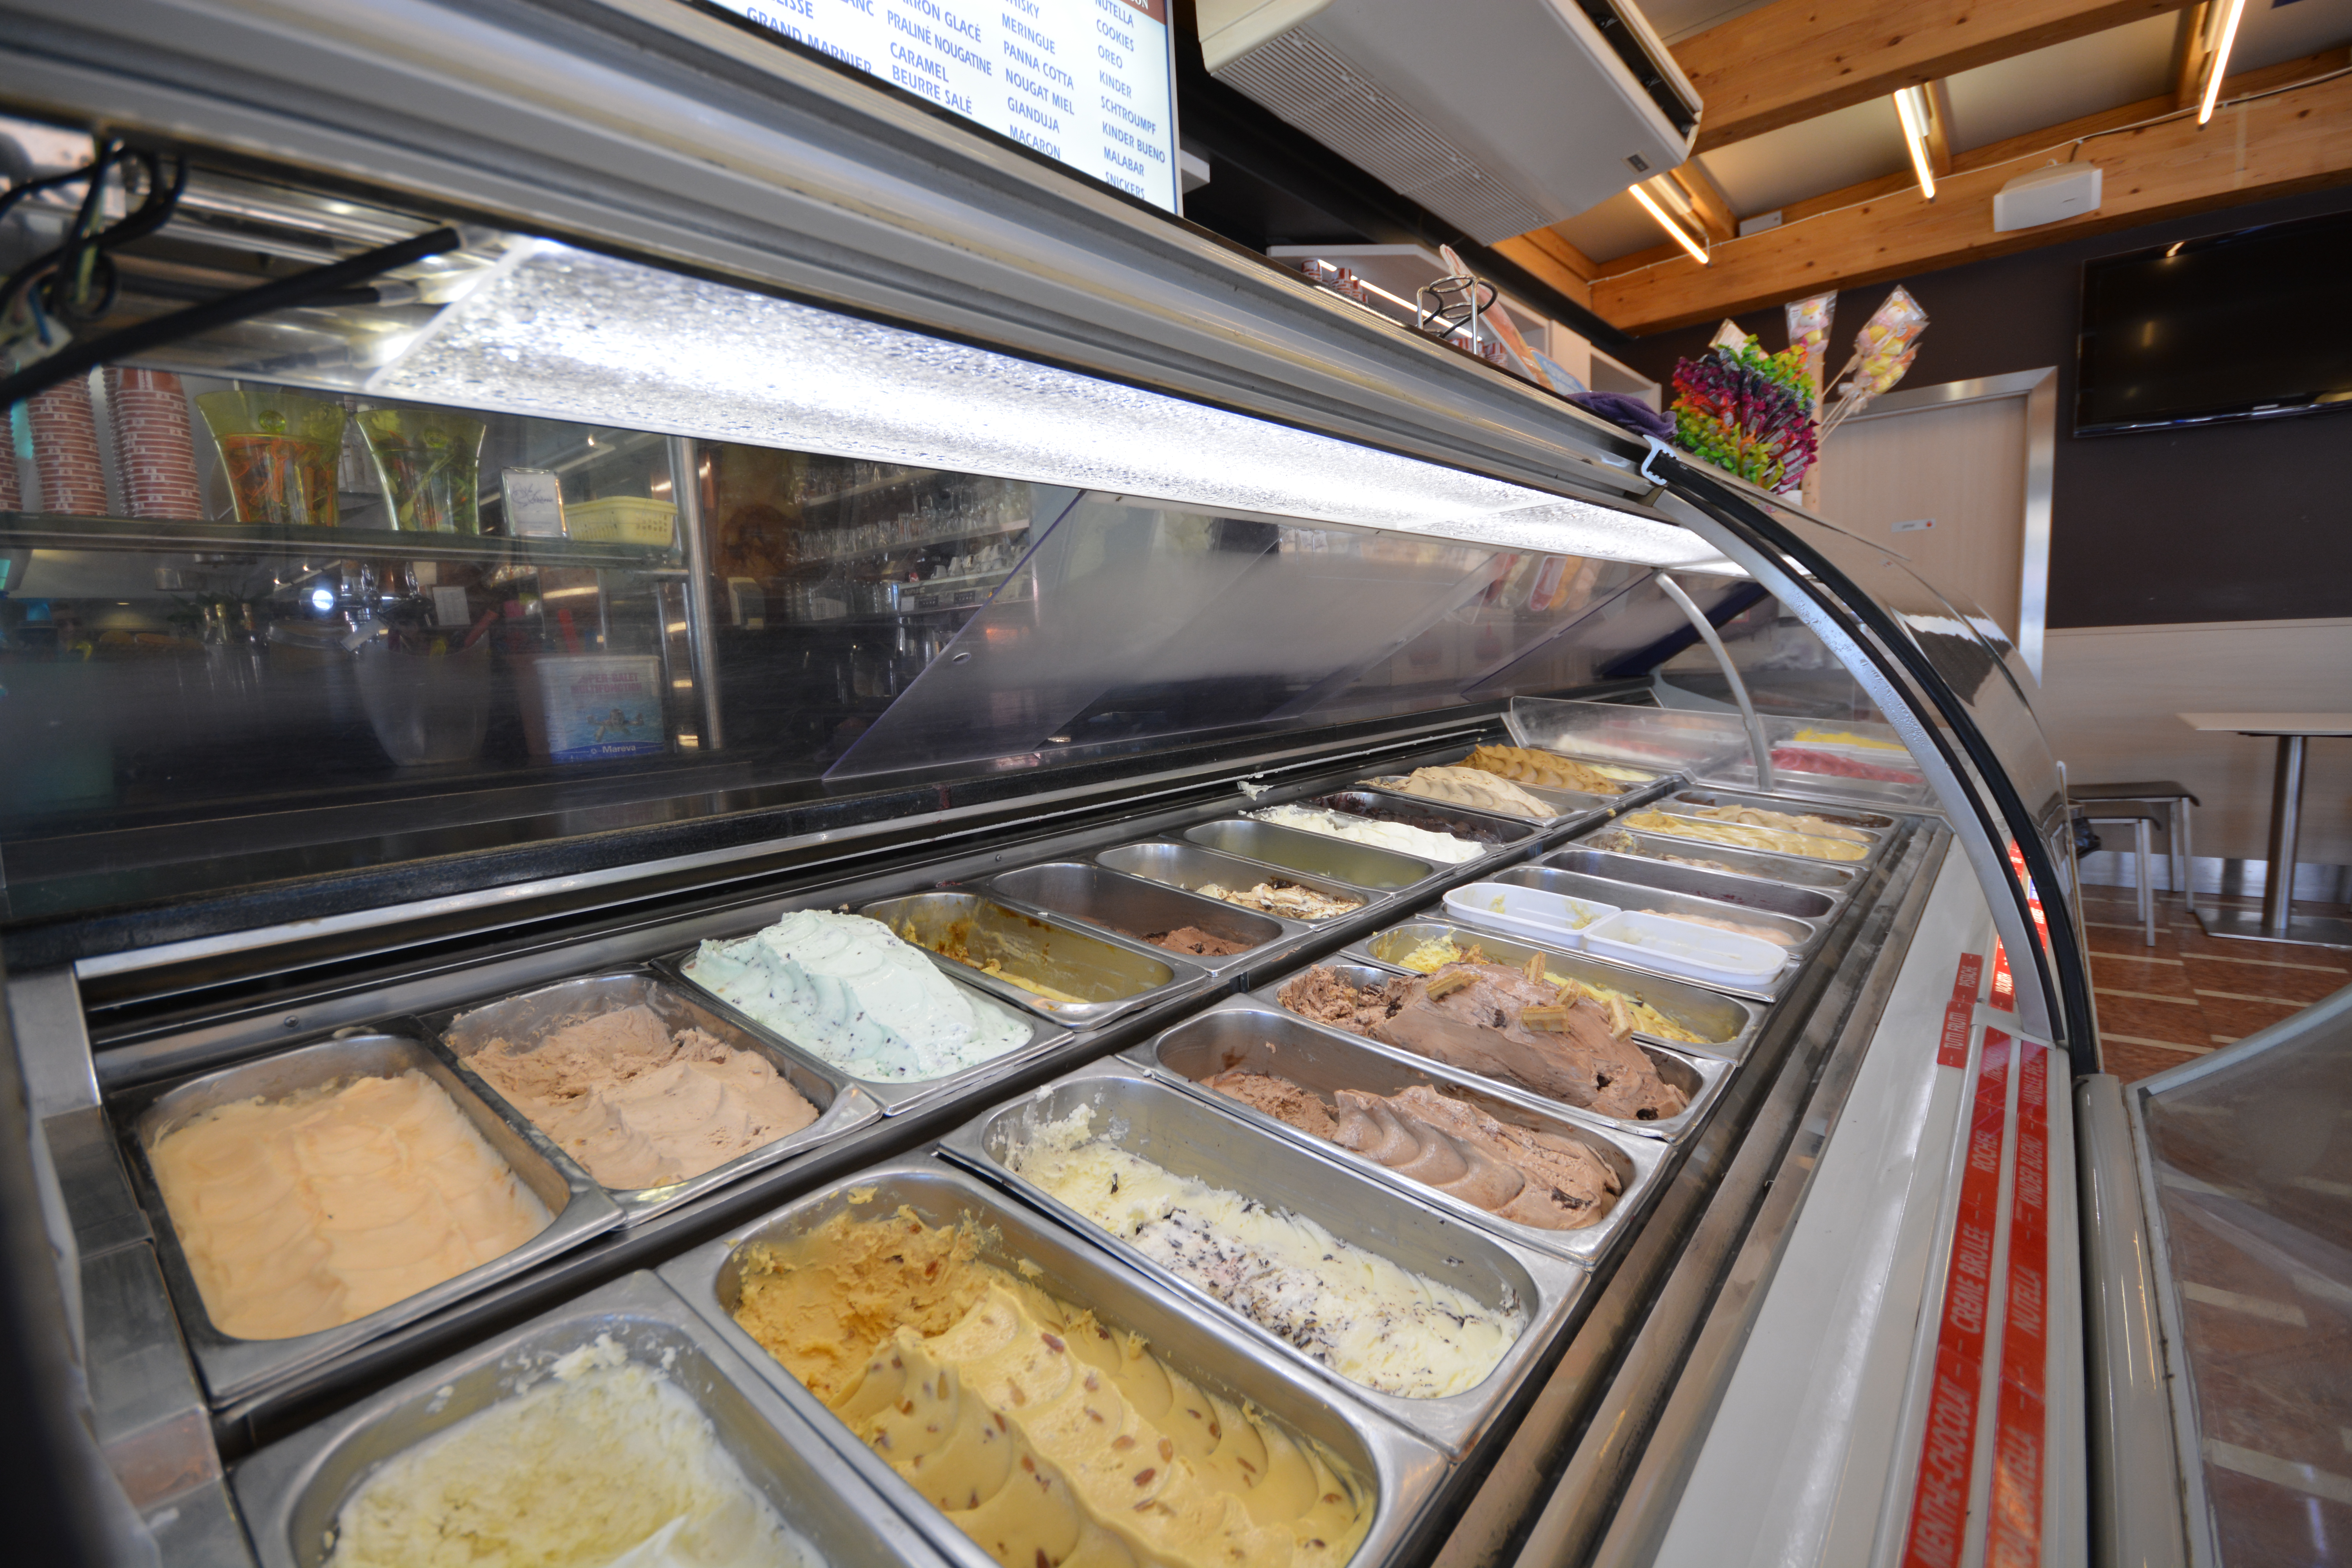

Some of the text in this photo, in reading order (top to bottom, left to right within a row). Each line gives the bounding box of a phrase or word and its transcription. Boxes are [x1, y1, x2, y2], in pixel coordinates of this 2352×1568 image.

[747, 7, 872, 74] GRAND MARNIER
[887, 9, 992, 76] PRALINÉ NOUGATINE
[945, 12, 981, 43] GLACÉ
[1002, 13, 1055, 54] MERINGUE
[1096, 19, 1134, 52] COOKIES
[890, 42, 949, 83] CARAMEL
[1004, 40, 1074, 90] PANNA COTTA
[1098, 45, 1123, 69] OREO
[892, 64, 973, 114] BEURRE SALÉ
[1005, 68, 1074, 115] NOUGAT MIEL
[1100, 70, 1132, 99] KINDER
[1007, 96, 1060, 133] GIANDUJA
[1101, 96, 1156, 135] SCHTROUMPF
[1010, 125, 1060, 160] MACARON
[1102, 121, 1165, 163] KINDER BUENO
[1104, 146, 1144, 176] MALABAR
[1105, 172, 1145, 200] SNICKERS
[1958, 965, 1978, 987] PISTACHE
[1995, 971, 2013, 995] YAOURTH
[1944, 1012, 1967, 1050] TUTTI FRUTTI
[1984, 1045, 2005, 1083] TIRAMISU
[2023, 1053, 2044, 1105] VANILLE PECAN
[1971, 1129, 1998, 1173] ROCHER
[2018, 1133, 2043, 1209] KINDER BUENO
[1949, 1223, 1990, 1334] CREME BRULEE
[2012, 1264, 2041, 1338] NUTELLA
[1913, 1374, 1972, 1568] MENTHE-CHOCOLAT
